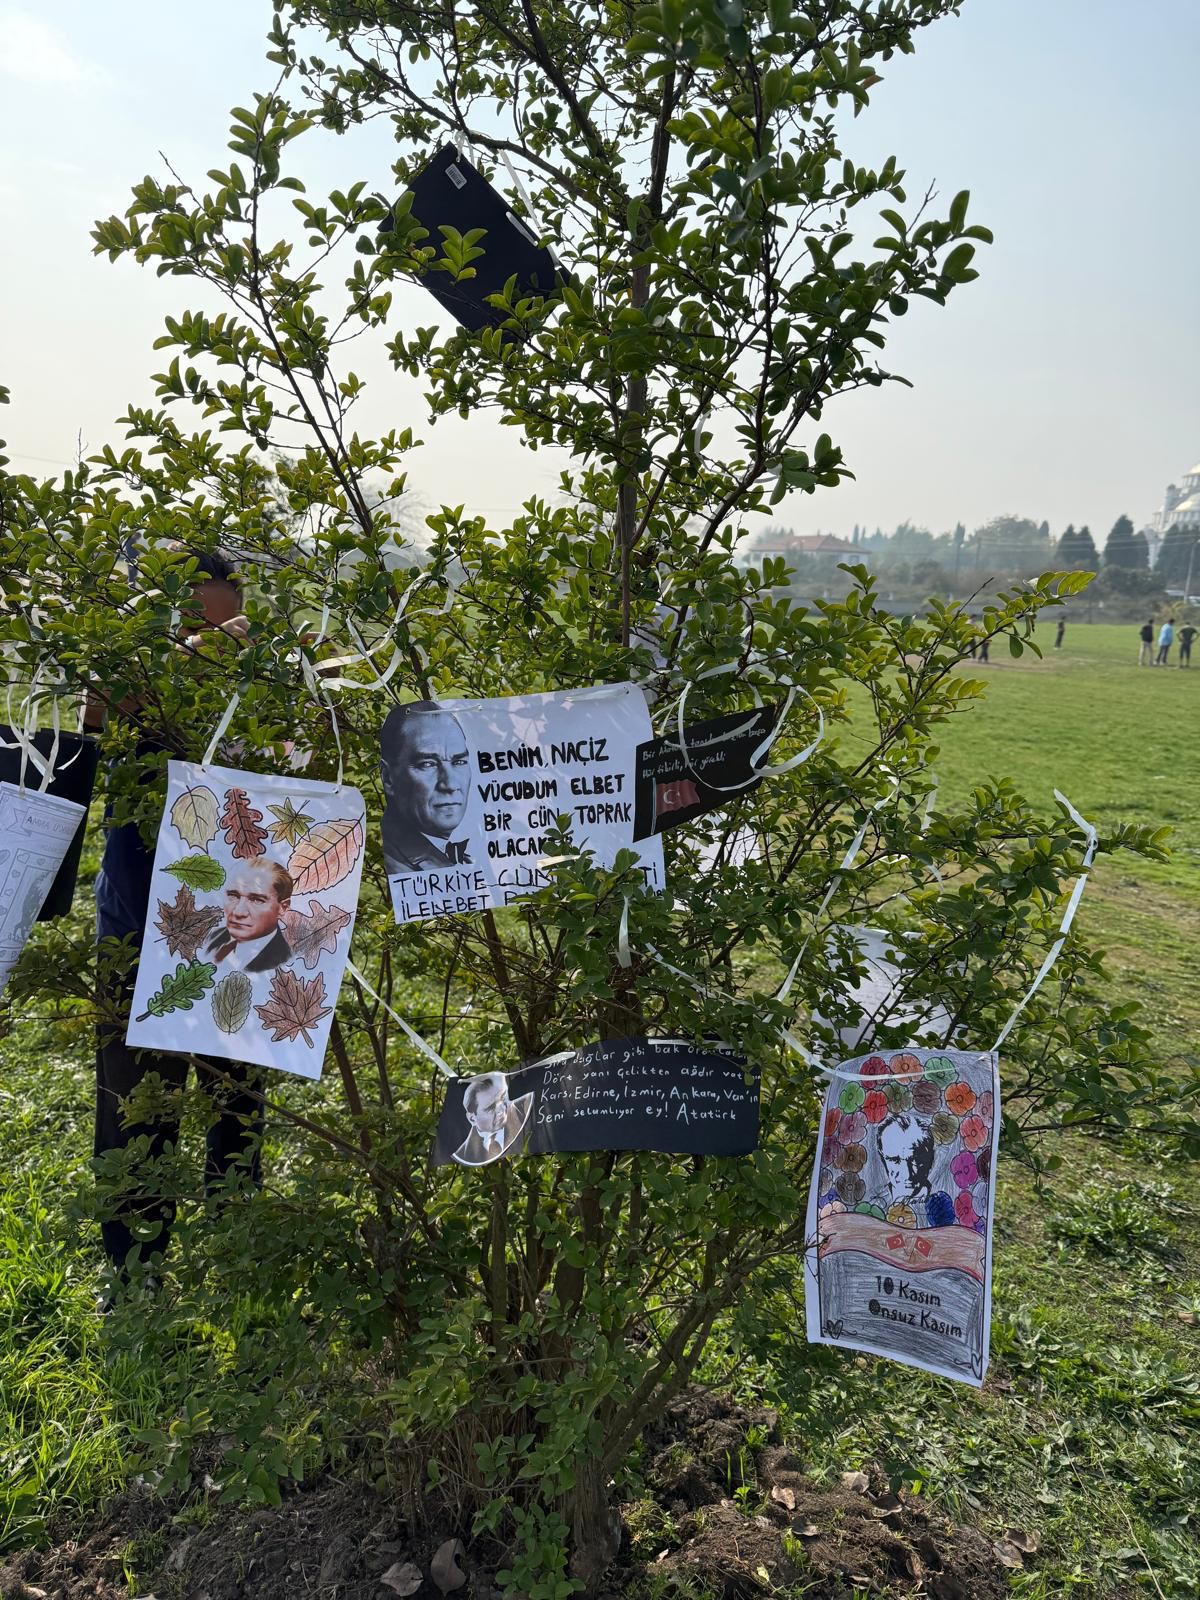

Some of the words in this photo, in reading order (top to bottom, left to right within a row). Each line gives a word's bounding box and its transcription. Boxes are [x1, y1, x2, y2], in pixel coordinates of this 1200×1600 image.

[551, 736, 610, 769] NAÇİZ
[642, 749, 656, 761] Bir
[477, 780, 558, 803] VÜCUDUM
[571, 774, 626, 796] ELBET
[483, 810, 512, 832] BİR
[527, 805, 560, 828] GÜN
[574, 802, 633, 825] TOPRAK
[393, 869, 485, 898] TÜRKİYE
[622, 1046, 645, 1063] gibi
[654, 1044, 680, 1054] bak
[543, 1070, 572, 1086] Dört
[582, 1070, 610, 1081] yanı
[574, 1086, 620, 1102] Edirne,
[669, 1085, 720, 1103] Ankara,
[536, 1105, 565, 1124] Seni
[645, 1101, 669, 1119] ey!
[676, 1102, 736, 1126] Atatürk
[875, 1275, 895, 1295] 10
[899, 1280, 941, 1307] Kasım
[869, 1299, 916, 1325] Onsuz
[920, 1309, 962, 1338] Kasım
